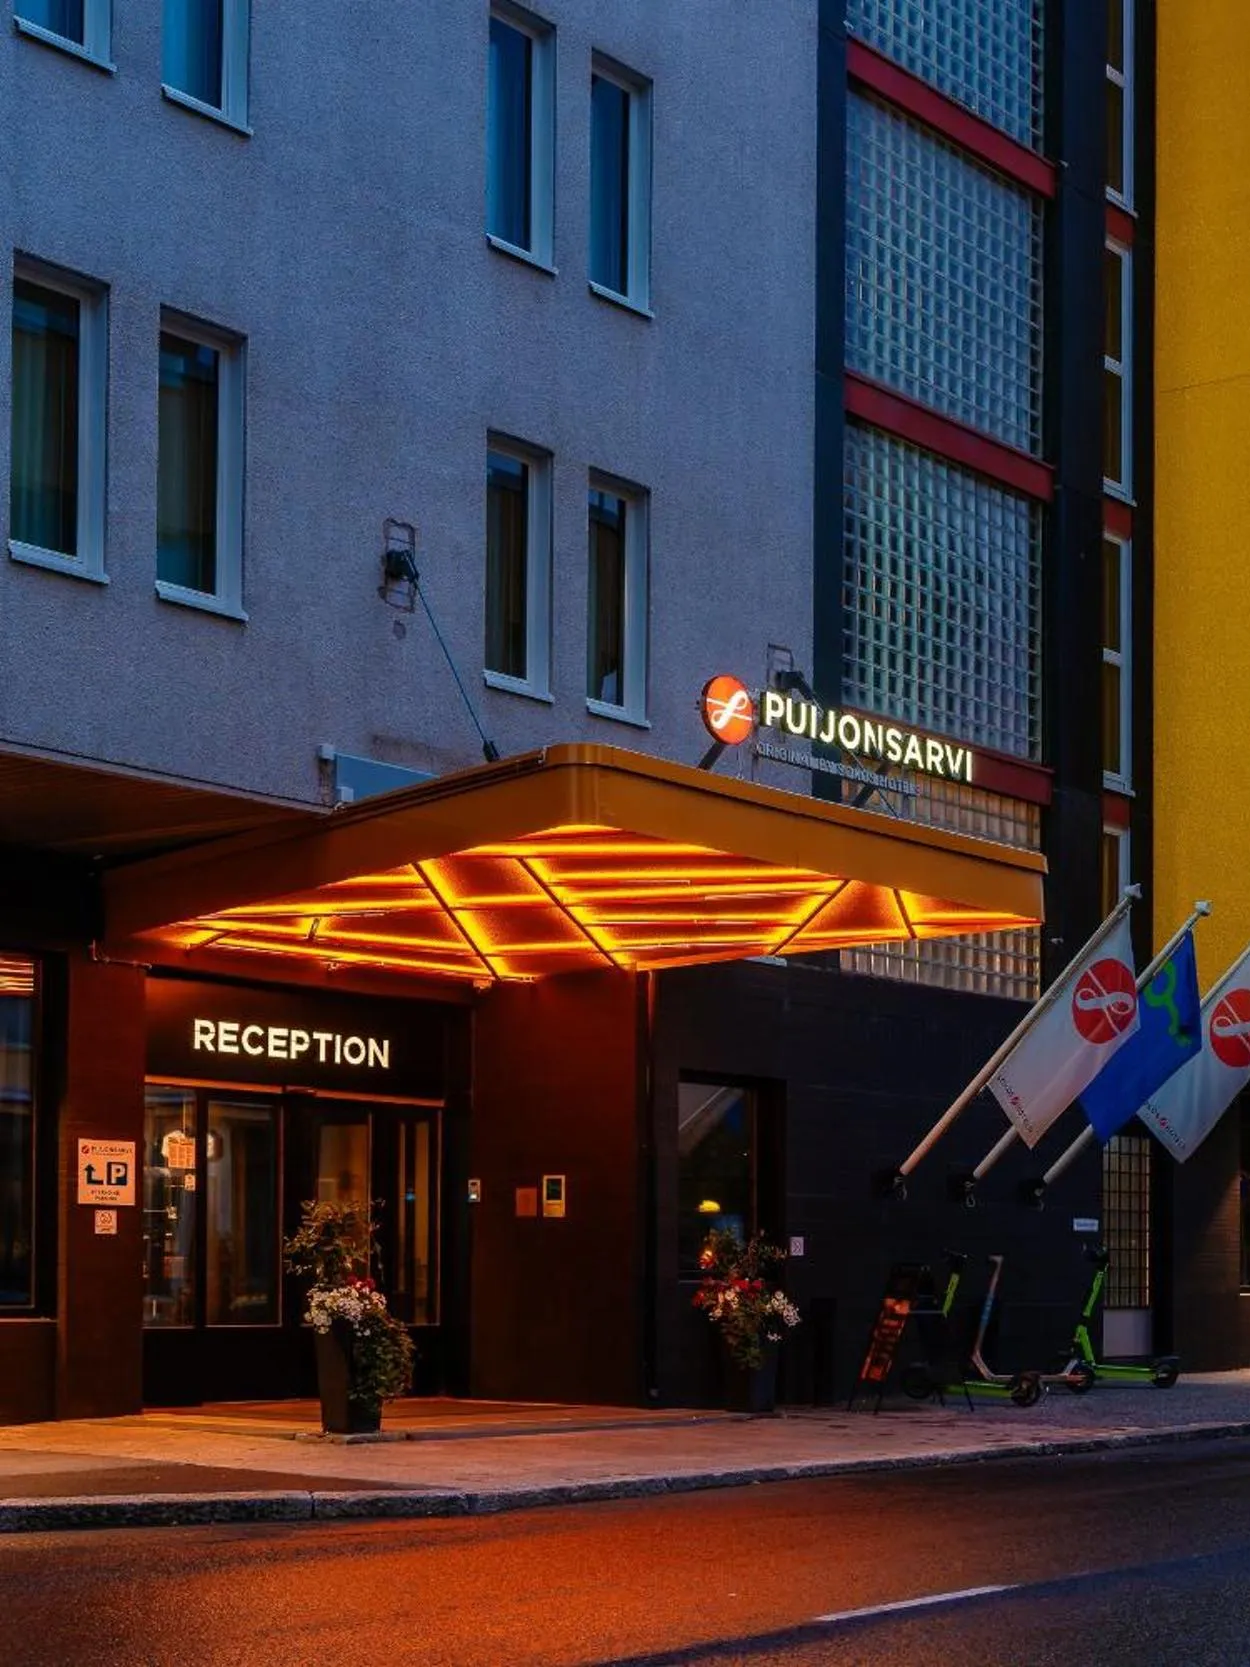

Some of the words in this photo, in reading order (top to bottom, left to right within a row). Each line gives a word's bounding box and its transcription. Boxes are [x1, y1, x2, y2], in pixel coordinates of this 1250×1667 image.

[765, 691, 973, 782] PUIJONSARVI
[193, 1018, 390, 1069] RECEPTION
[111, 1163, 126, 1184] P
